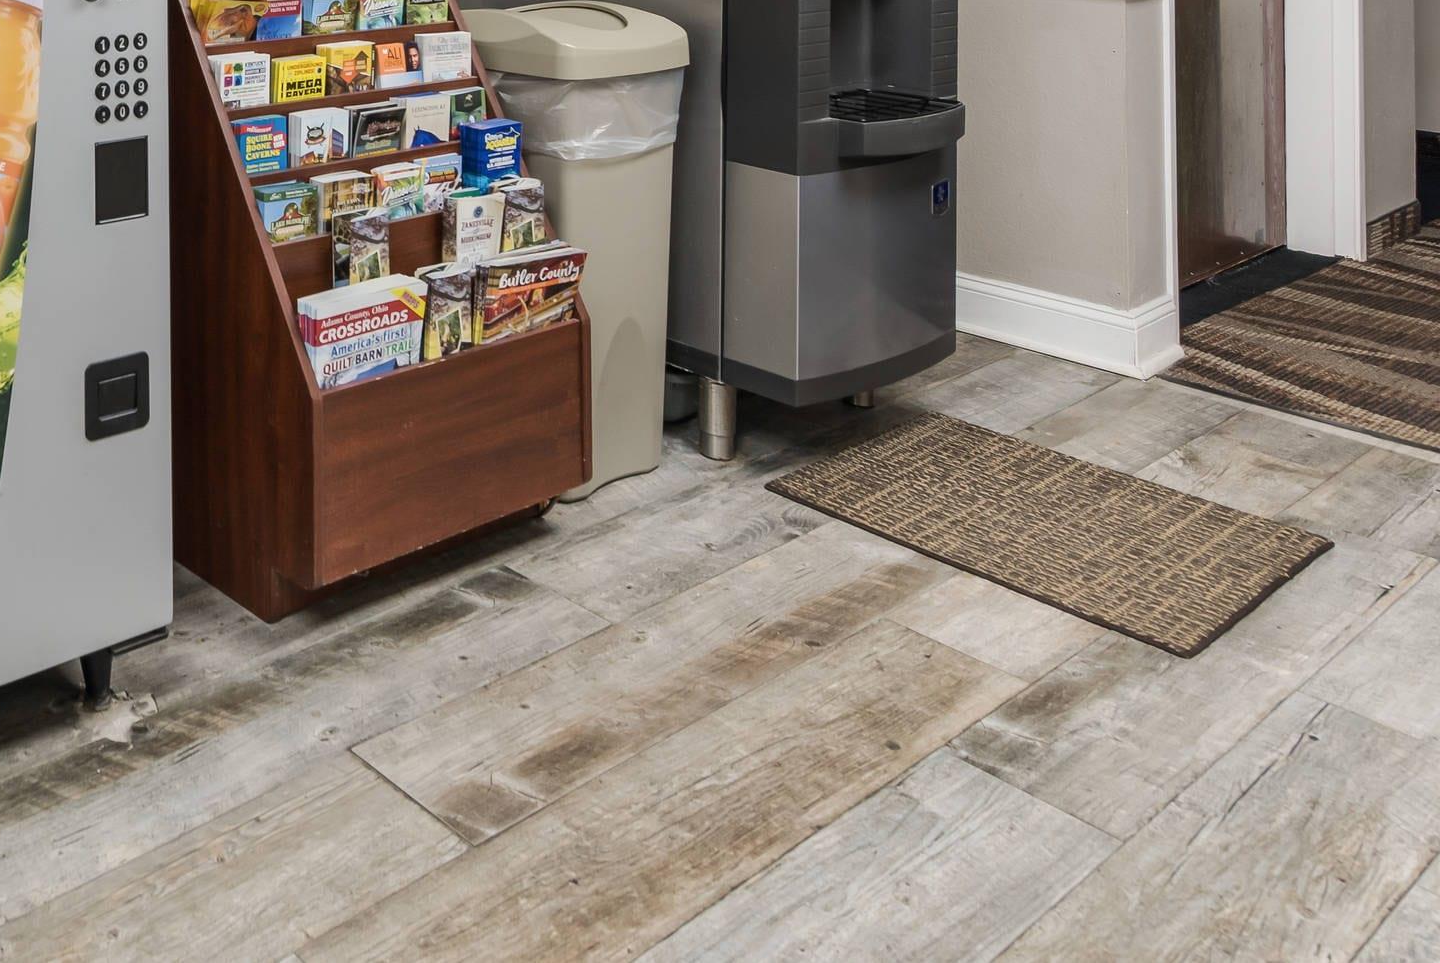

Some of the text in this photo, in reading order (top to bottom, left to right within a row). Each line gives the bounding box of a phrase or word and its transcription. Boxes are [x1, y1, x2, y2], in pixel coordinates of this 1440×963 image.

[100, 35, 145, 51] 1 2 3
[387, 47, 402, 61] ALI
[100, 58, 145, 74] 4 5 6
[100, 80, 145, 98] 7 8 9
[285, 87, 322, 98] CAVERN
[286, 78, 322, 91] MEGA
[119, 106, 126, 118] 0
[245, 148, 281, 161] CAVERNS
[498, 259, 580, 289] Butler County
[320, 317, 343, 330] Adams
[371, 304, 389, 315] Ohio
[318, 308, 409, 344] CROSSROADS
[330, 327, 405, 358] America's first
[323, 338, 414, 376] QUILT BARN TRAIL
